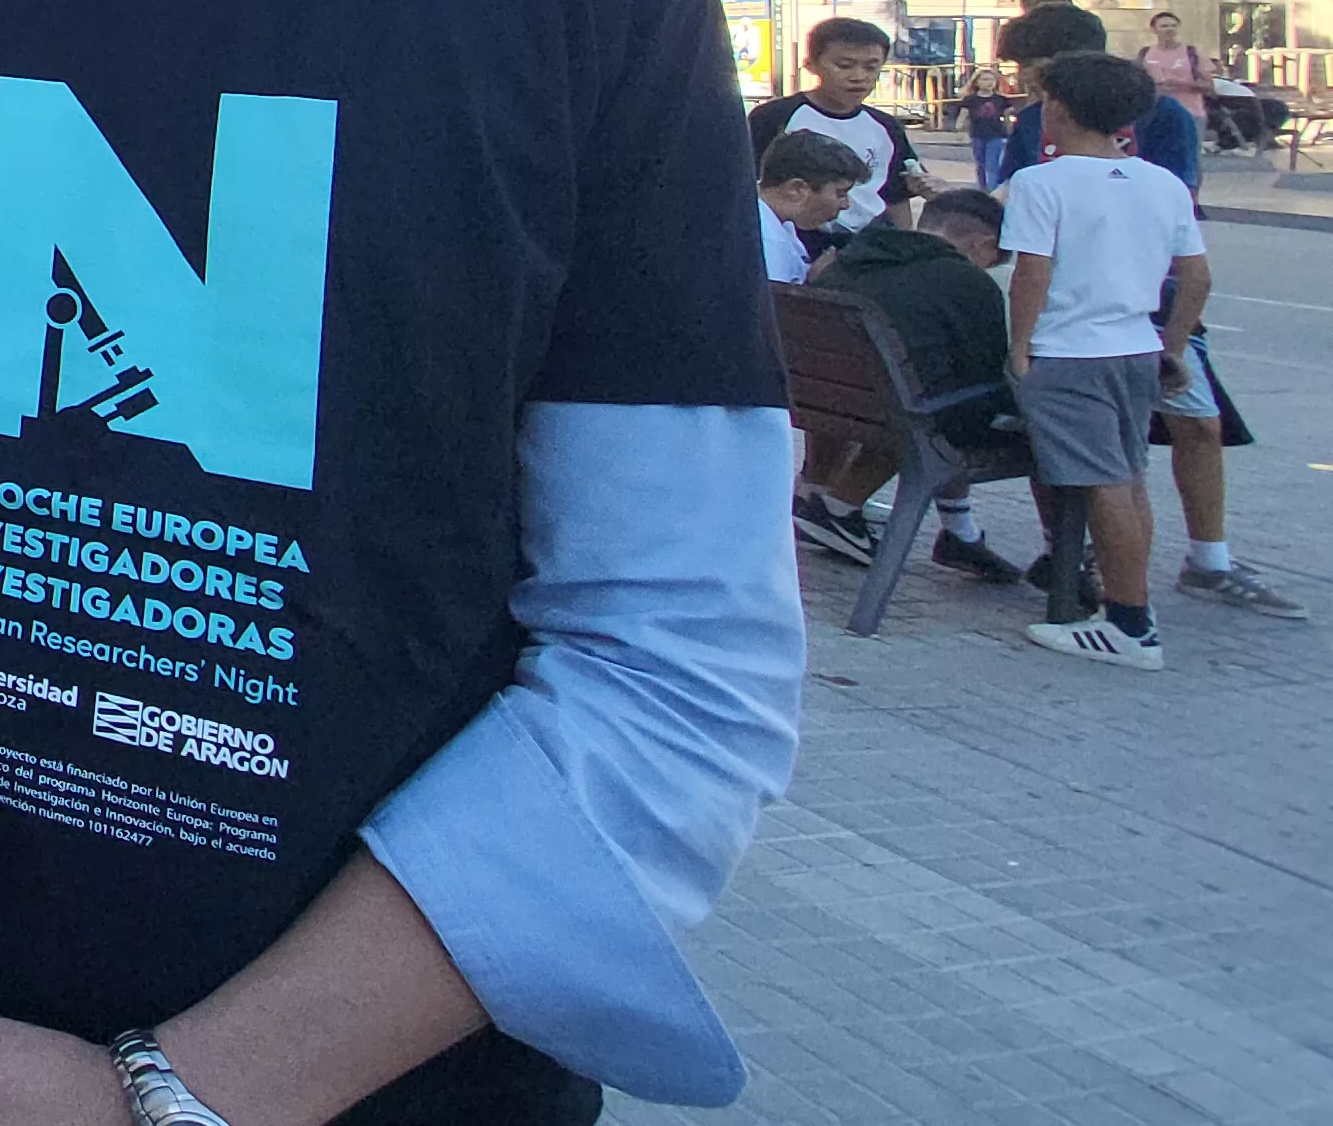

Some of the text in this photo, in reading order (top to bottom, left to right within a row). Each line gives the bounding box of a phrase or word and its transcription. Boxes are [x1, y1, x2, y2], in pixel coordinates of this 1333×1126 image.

[111, 502, 310, 574] EUROPEA
[214, 663, 300, 707] Night
[139, 726, 290, 780] DE ARAGON
[142, 706, 275, 755] GOBIERNO
[13, 781, 91, 814] Investigación
[93, 807, 103, 818] e
[179, 829, 208, 847] bajo
[210, 837, 223, 850] el
[225, 841, 277, 862] acuerdo
[14, 765, 34, 780] del
[38, 774, 97, 799] programa
[101, 789, 162, 817] Horizonte
[219, 822, 278, 845] Programa
[39, 756, 65, 773] está
[66, 762, 129, 791] financiado
[131, 783, 153, 798] por
[155, 786, 167, 801] la
[169, 791, 208, 812] Unión
[210, 802, 260, 825] Europea
[261, 814, 279, 827] en
[38, 807, 86, 829] número
[88, 819, 154, 848] 101162477
